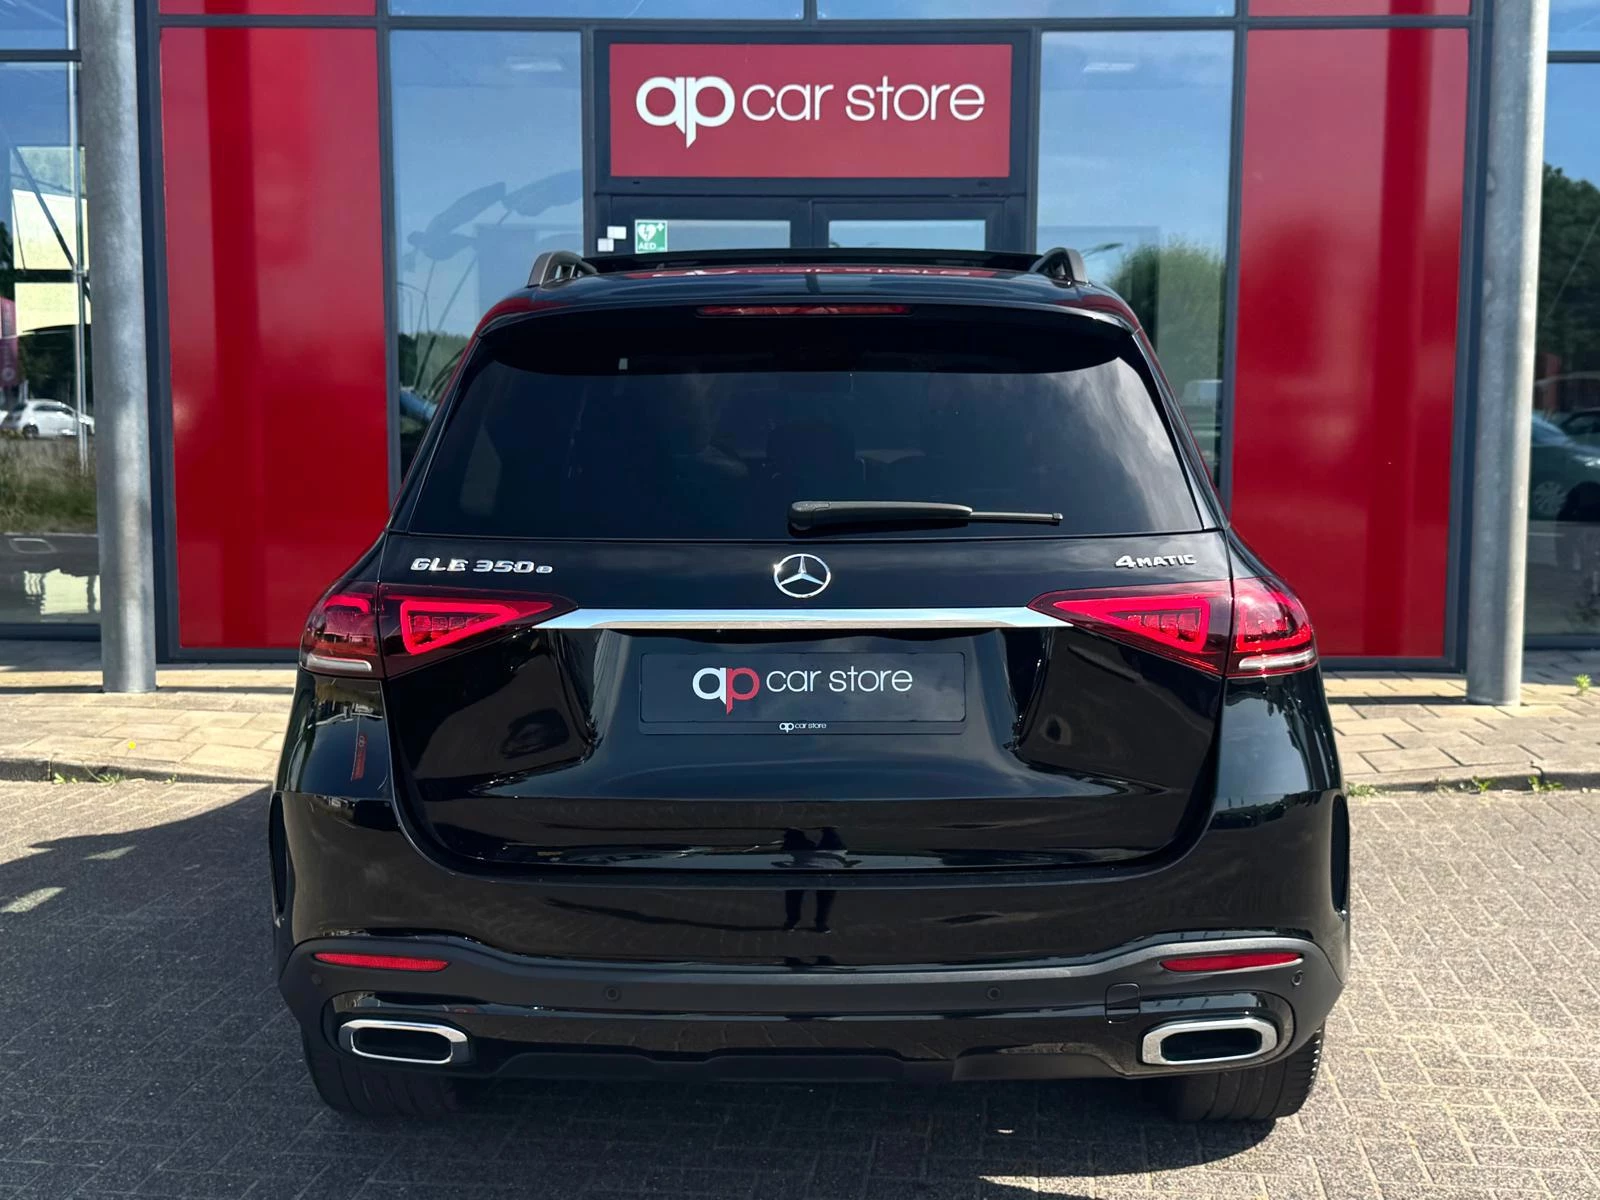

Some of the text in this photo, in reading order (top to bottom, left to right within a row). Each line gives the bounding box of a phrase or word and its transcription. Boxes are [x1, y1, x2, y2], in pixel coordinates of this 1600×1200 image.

[742, 83, 834, 122] car
[845, 75, 985, 122] store
[638, 242, 657, 250] AED
[410, 558, 553, 574] GLE 350e
[1115, 554, 1197, 569] 4MATIC
[766, 669, 822, 692] car
[828, 666, 913, 692] store
